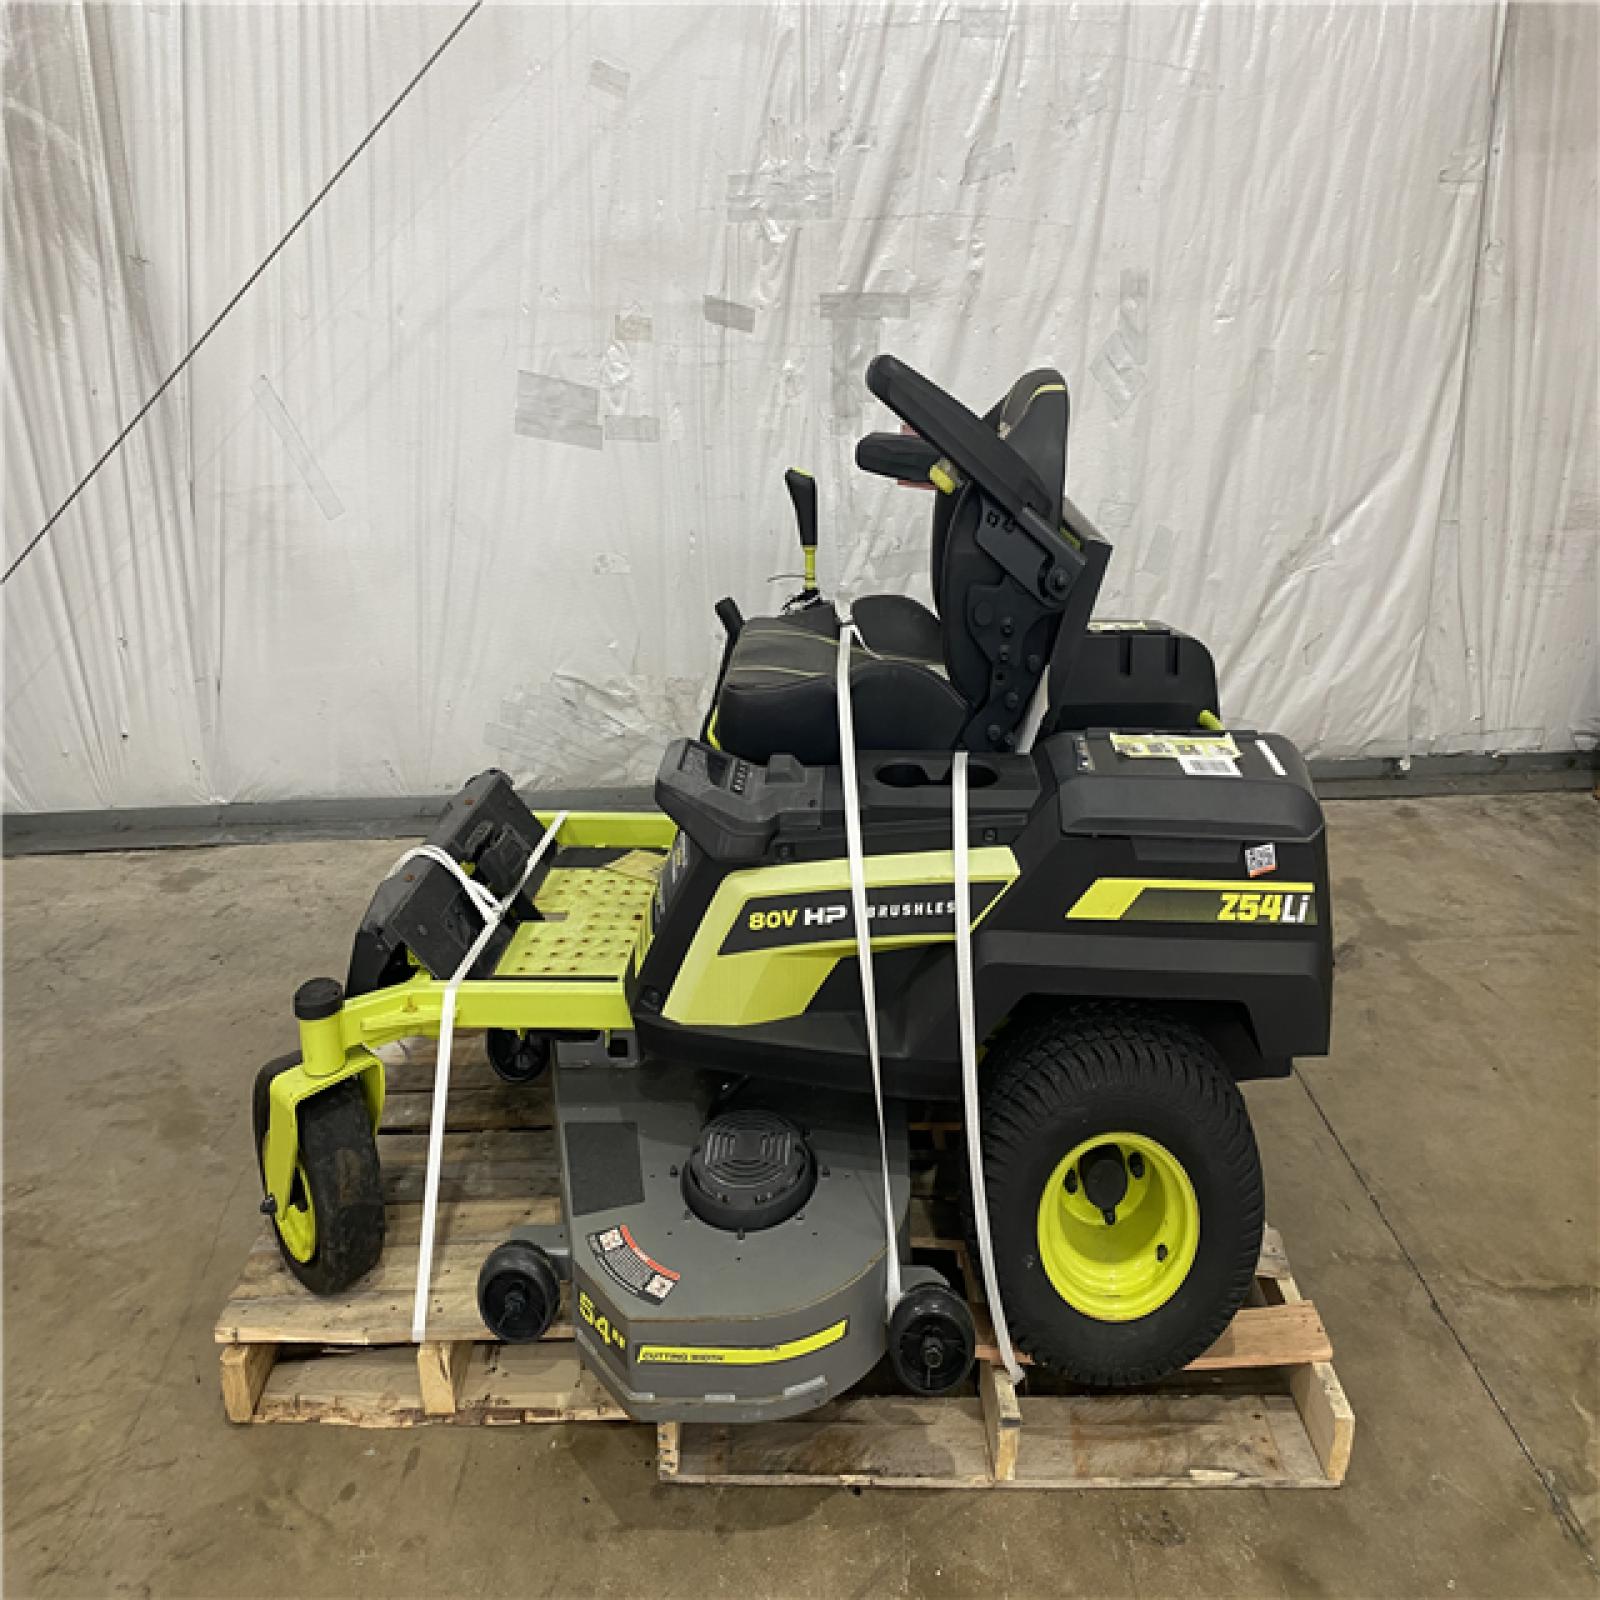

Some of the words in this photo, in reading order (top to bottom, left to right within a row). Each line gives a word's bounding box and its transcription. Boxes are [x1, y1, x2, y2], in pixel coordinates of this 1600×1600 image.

[750, 909, 799, 931] 80V
[804, 904, 848, 926] HP
[867, 900, 956, 919] BRUSHLES
[1217, 892, 1311, 923] Z54Li
